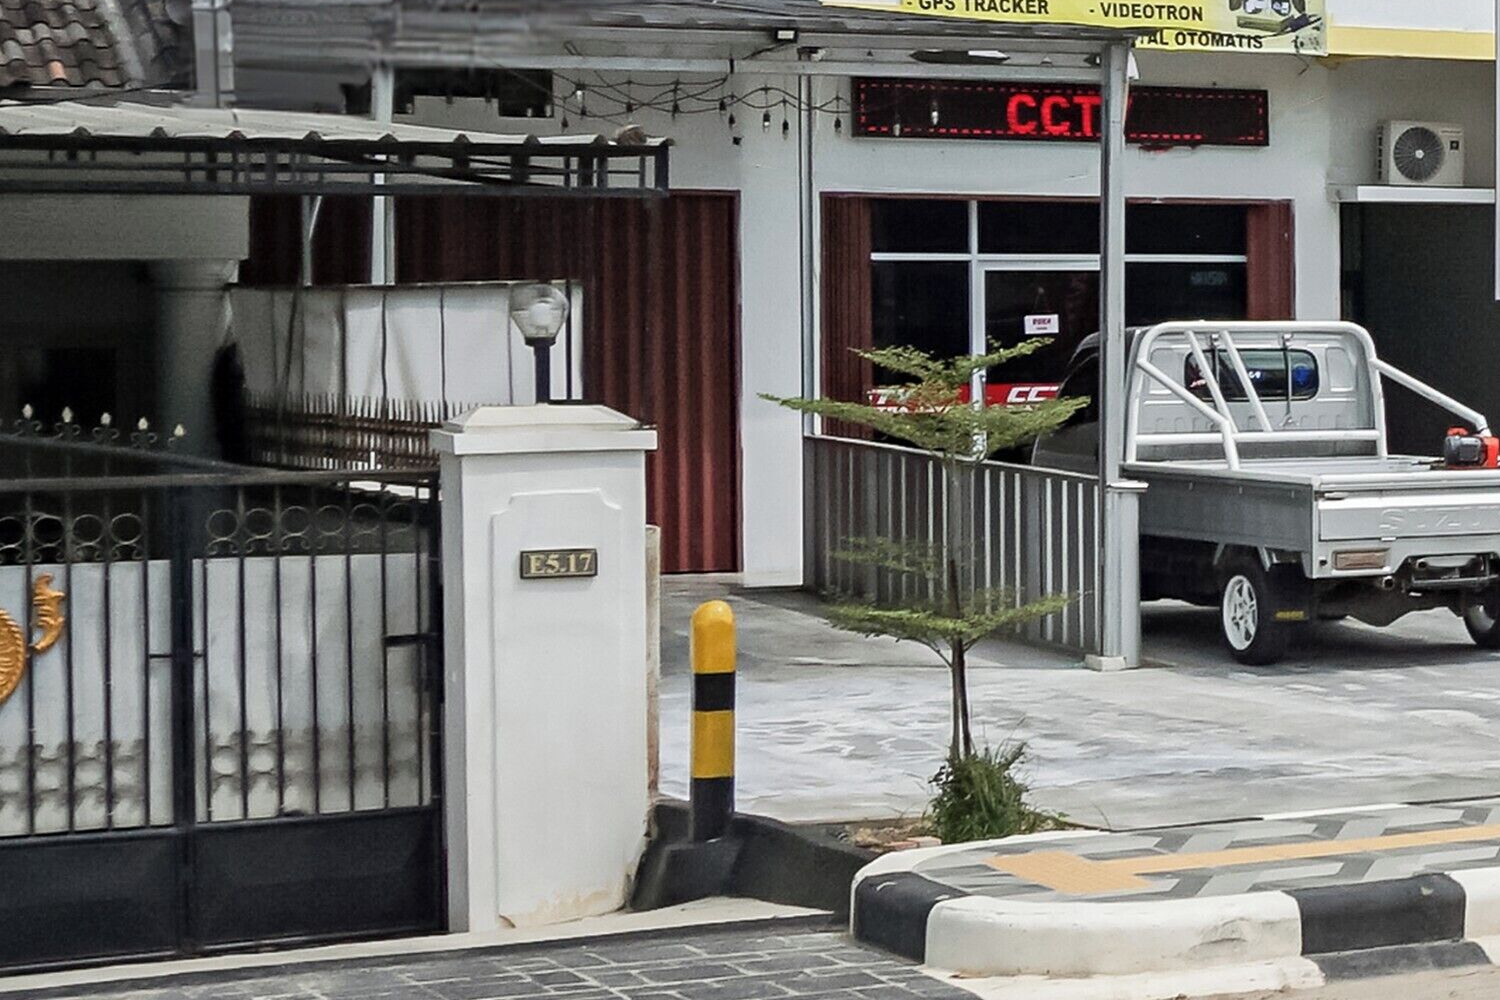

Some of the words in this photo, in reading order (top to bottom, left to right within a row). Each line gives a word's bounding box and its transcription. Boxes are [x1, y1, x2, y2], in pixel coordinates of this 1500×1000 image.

[1100, 2, 1203, 22] VIDEOTRON
[1006, 93, 1132, 137] CCT
[529, 552, 593, 574] E5.17
